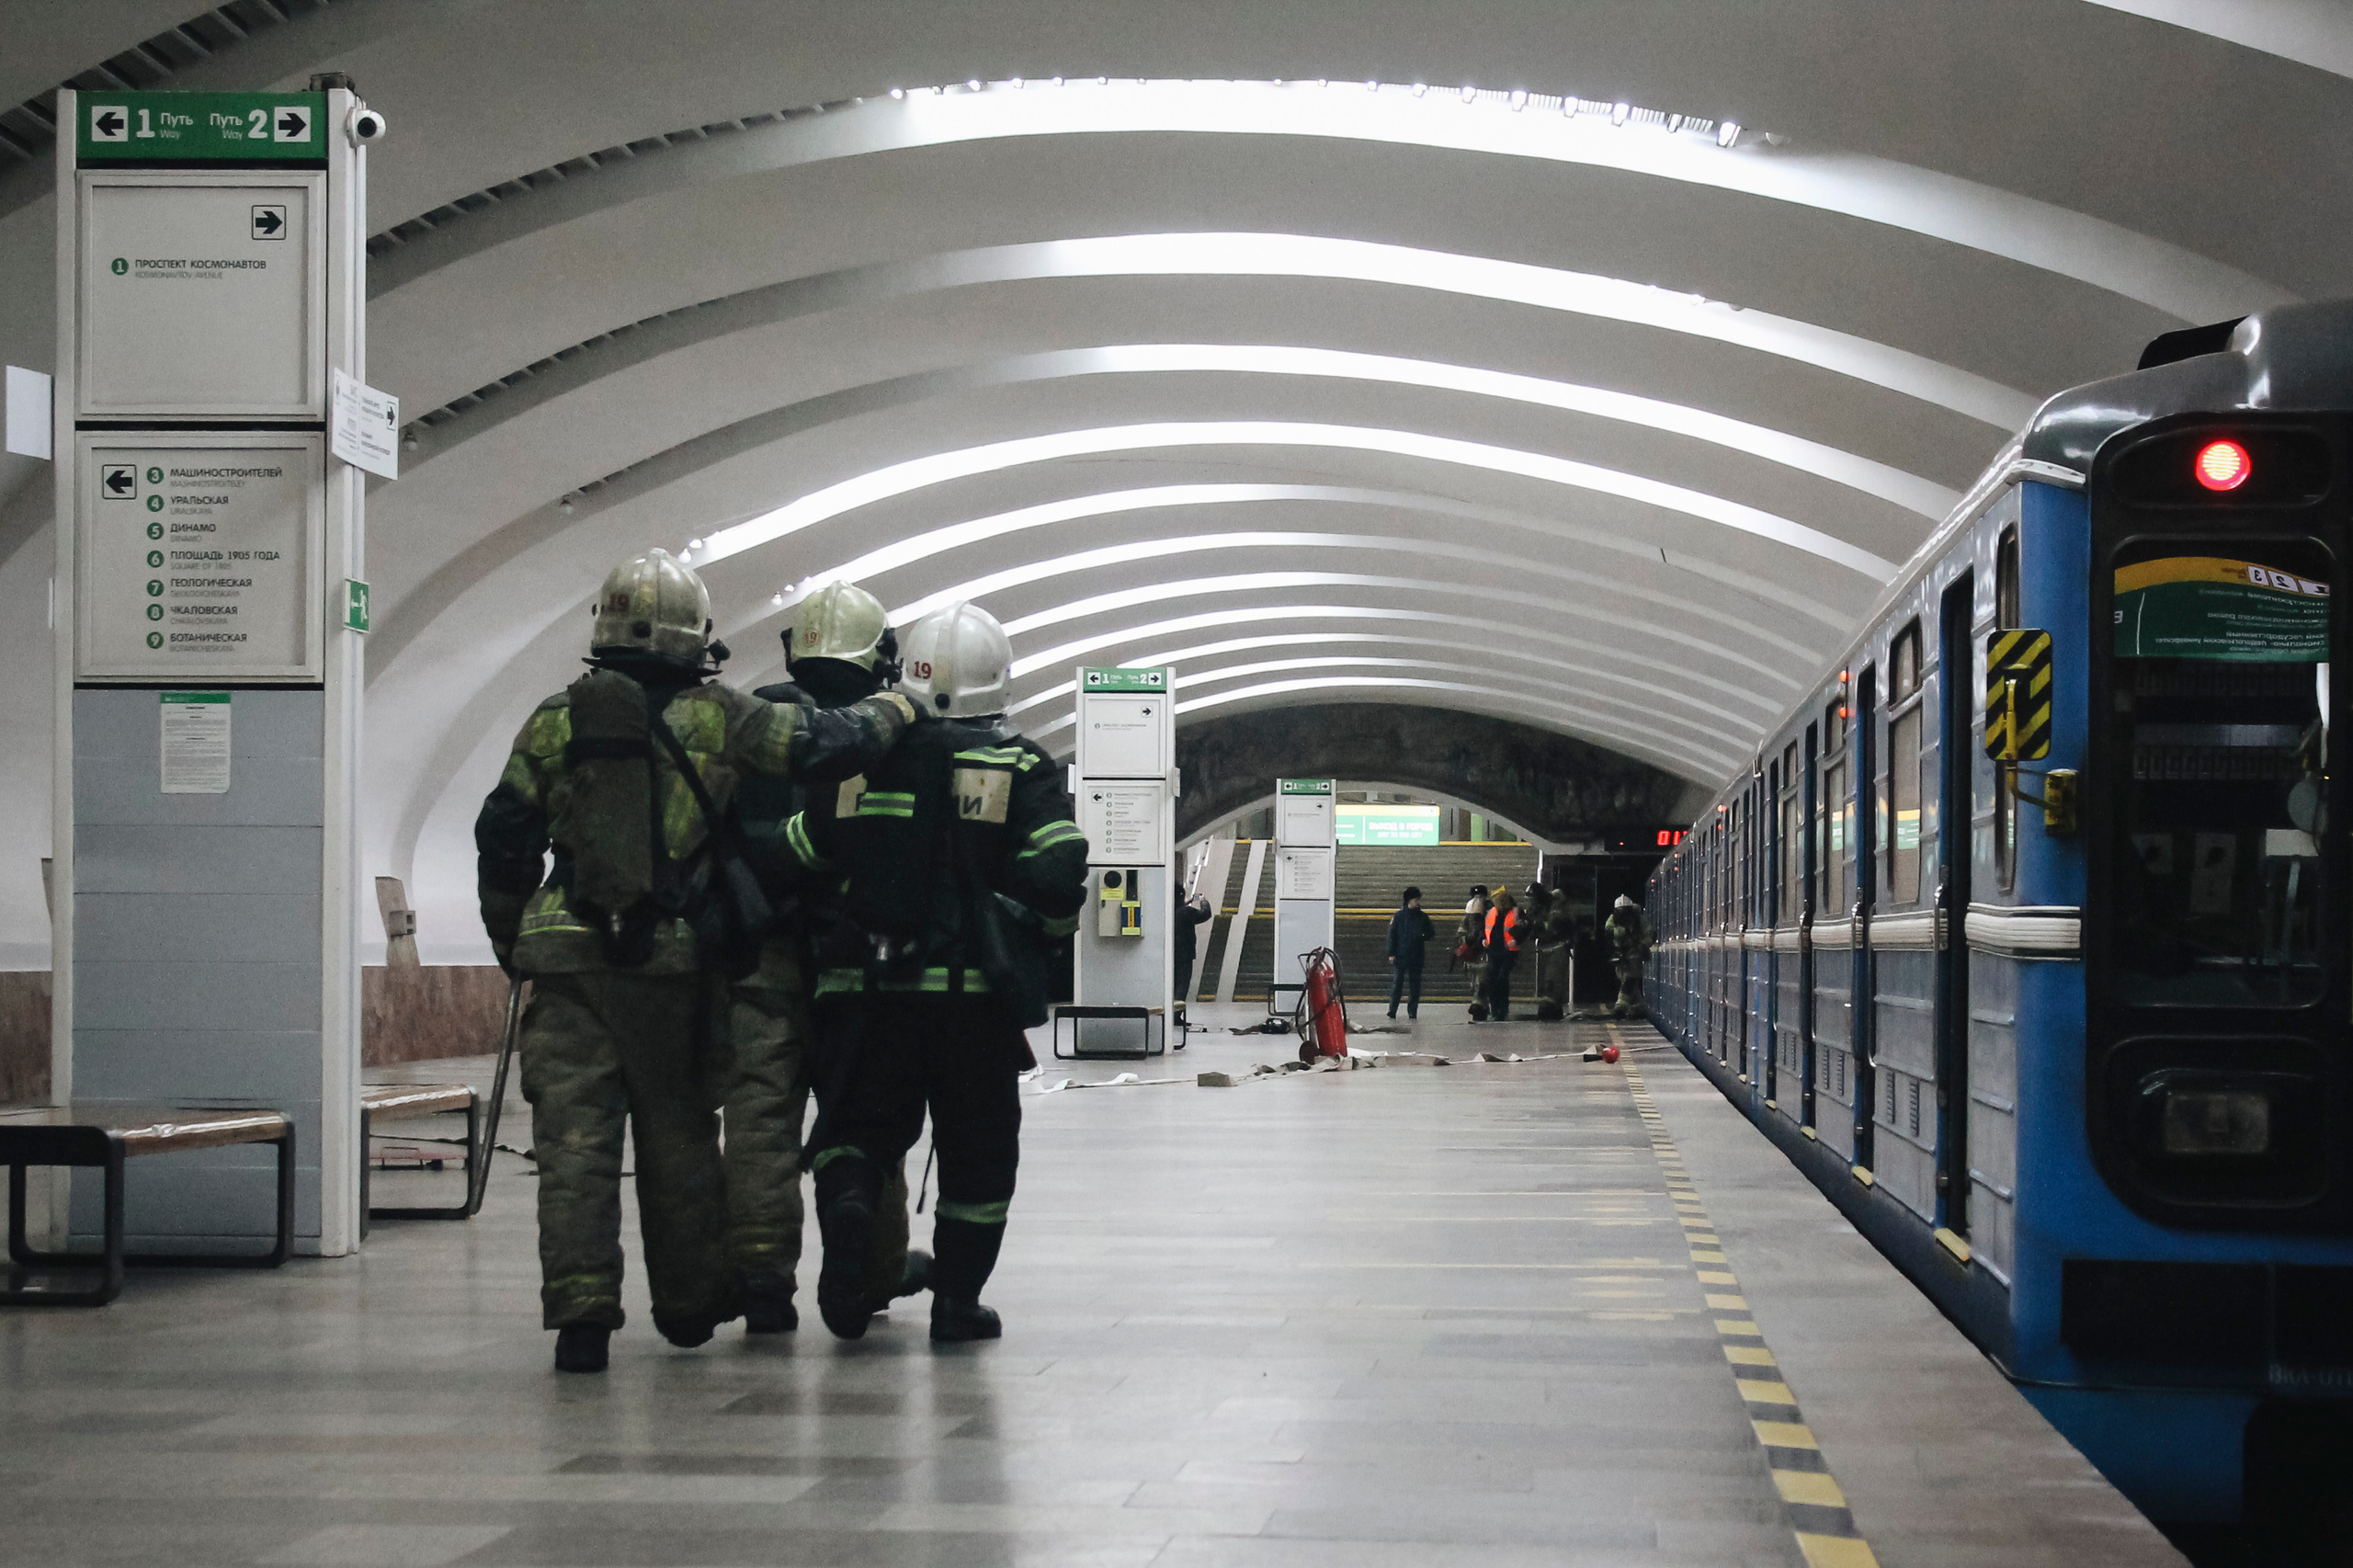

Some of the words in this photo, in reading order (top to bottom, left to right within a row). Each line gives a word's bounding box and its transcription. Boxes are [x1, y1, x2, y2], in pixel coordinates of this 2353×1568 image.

[136, 108, 155, 138] 1
[161, 112, 194, 128] Путь
[210, 113, 244, 129] Путь
[247, 108, 268, 139] 2
[160, 130, 182, 140] Way
[222, 130, 243, 140] Way
[116, 260, 124, 273] 1
[135, 259, 188, 268] ПРОСПЕКТ
[190, 259, 267, 269] КОСМОНАВТОВ
[151, 470, 160, 482] 3
[170, 467, 283, 478] МАШИНОСТРОИТЕЛЕЙ
[151, 497, 160, 509] 4
[170, 496, 229, 505] УРАЛЬСКАЯ
[151, 525, 160, 538] 5
[170, 524, 216, 533] ДИНАМО
[151, 553, 160, 565] 6
[170, 551, 223, 561] ПЛОЩАДЬ
[228, 551, 250, 560] 1905
[254, 551, 280, 561] ГОДА
[151, 582, 160, 595] 7
[170, 579, 252, 587] ГЕОЛОГИЧЕСКАЯ
[151, 607, 160, 619] 8
[170, 606, 238, 615] ЧКАЛОВСКАЯ
[151, 634, 161, 646] 9
[170, 633, 247, 642] БОТАНИЧЕСКАЯ
[914, 661, 932, 679] 19
[1103, 673, 1110, 684] 1
[1140, 673, 1147, 684] 2
[1657, 830, 1688, 846] 01
